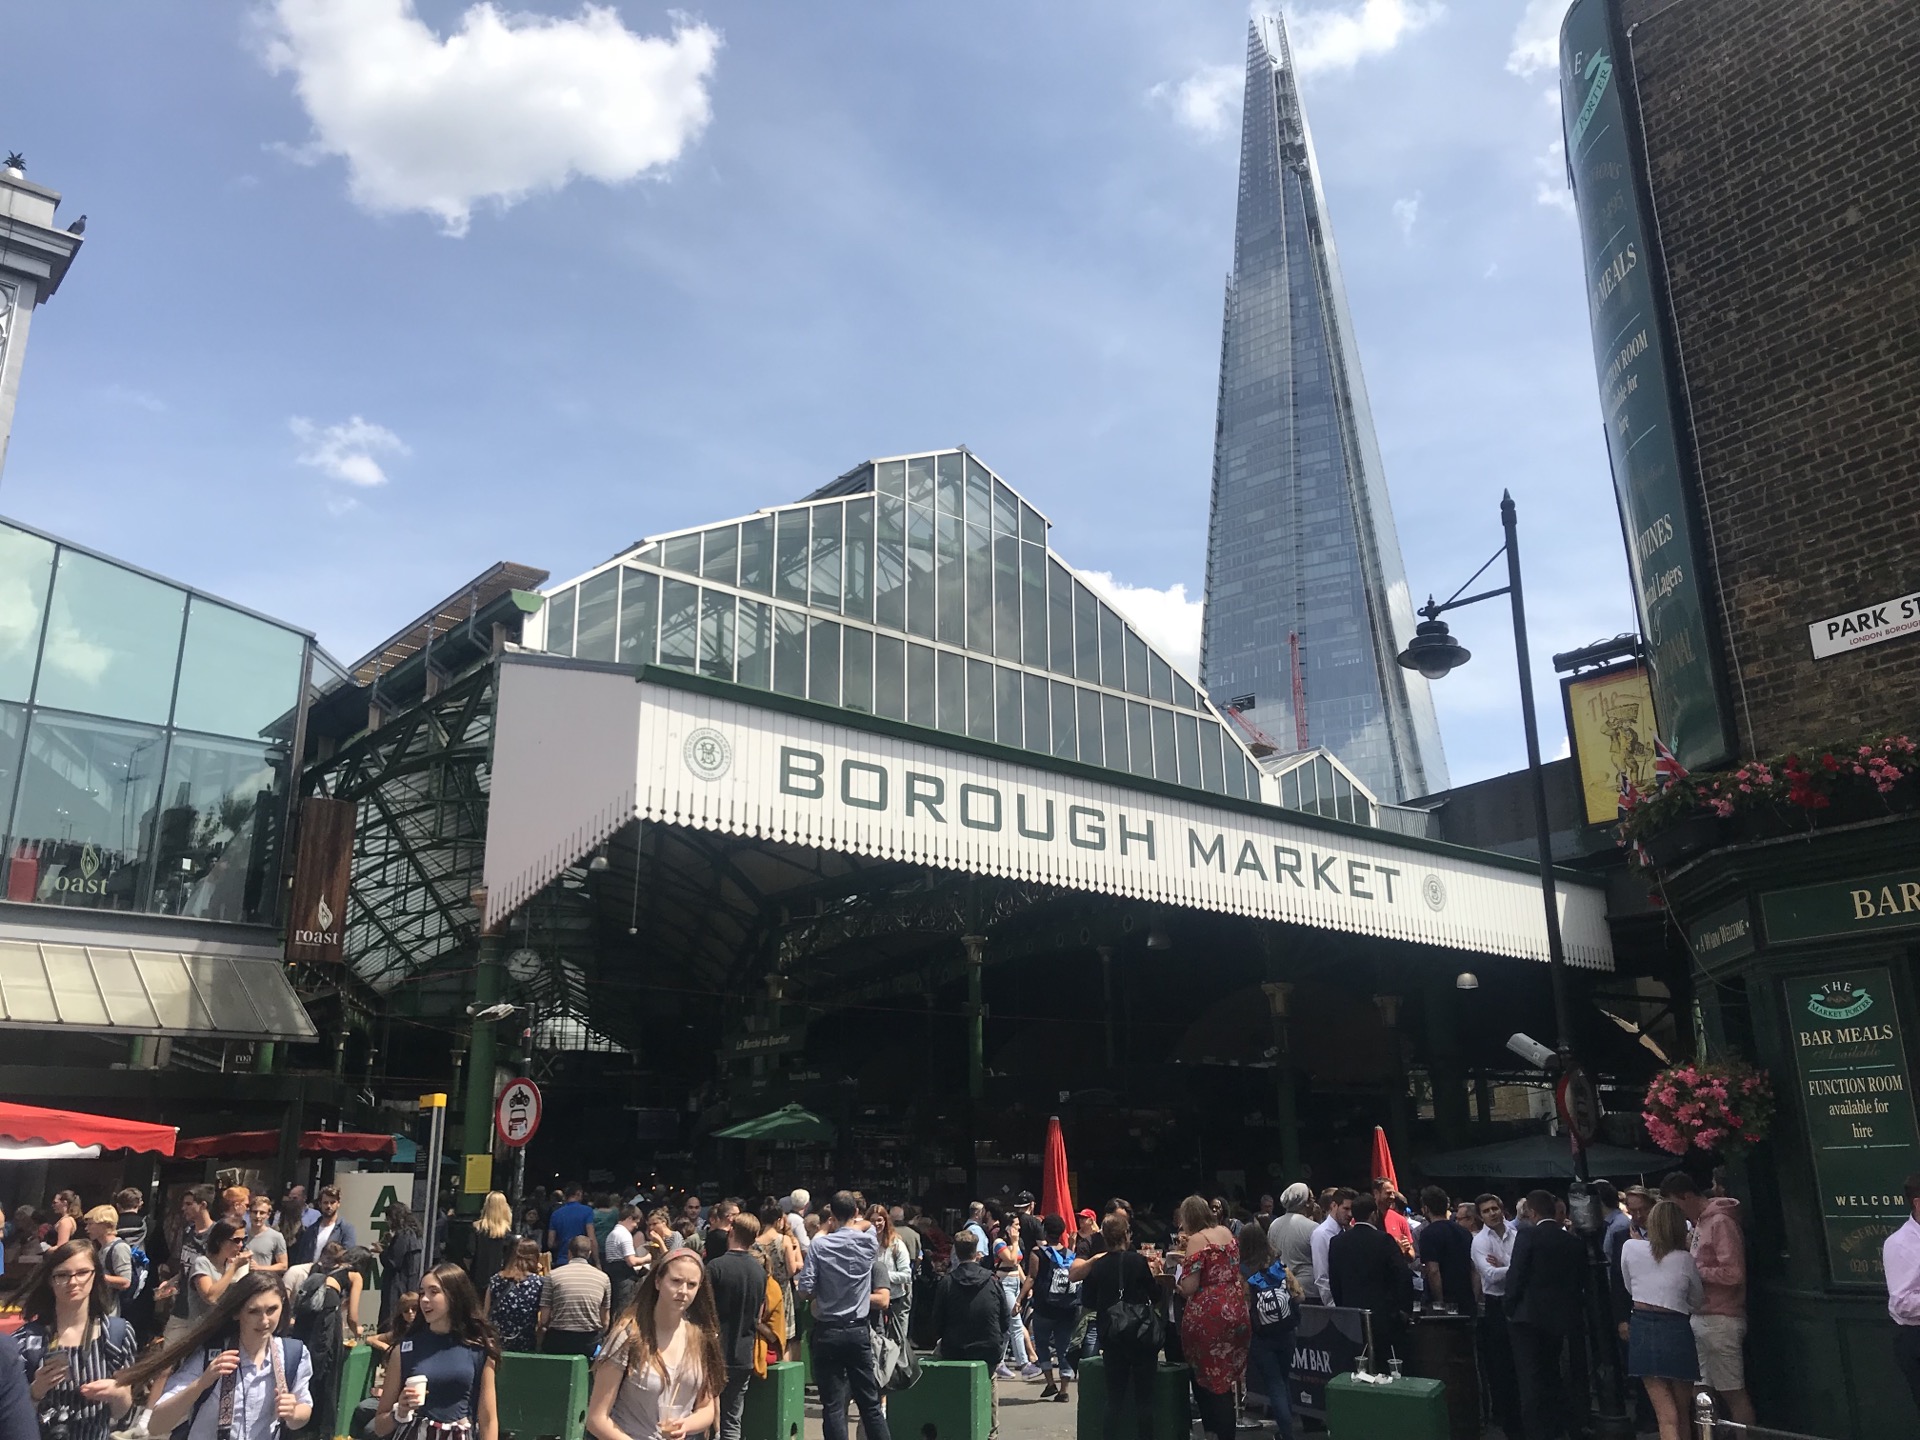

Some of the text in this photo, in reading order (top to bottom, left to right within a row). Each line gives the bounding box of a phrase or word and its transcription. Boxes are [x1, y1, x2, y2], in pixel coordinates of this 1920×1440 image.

[1579, 69, 1609, 129] PORTER
[1598, 242, 1637, 305] MEALS
[1622, 329, 1649, 370] ROOM
[1627, 374, 1638, 396] for
[1639, 513, 1674, 562] WINES
[1655, 565, 1684, 597] Lagers
[1827, 607, 1890, 640] PARK
[1849, 631, 1882, 645] LONDON
[1588, 691, 1619, 722] The
[780, 745, 1401, 904] BOROUGH MARKET
[44, 875, 109, 896] oast
[1850, 882, 1920, 920] BAR
[295, 929, 339, 945] roast
[1821, 981, 1852, 995] THE
[1810, 999, 1872, 1018] MARKET PORTER
[1800, 1024, 1894, 1047] BAR MEALS
[235, 1054, 252, 1063] roa
[1808, 1075, 1904, 1096] FUNCTION ROOM
[1829, 1098, 1890, 1116] available for
[1852, 1122, 1874, 1138] hire
[1835, 1195, 1905, 1206] WELCOM
[1841, 1224, 1896, 1253] RESERVAT
[1309, 1349, 1332, 1373] BAR
